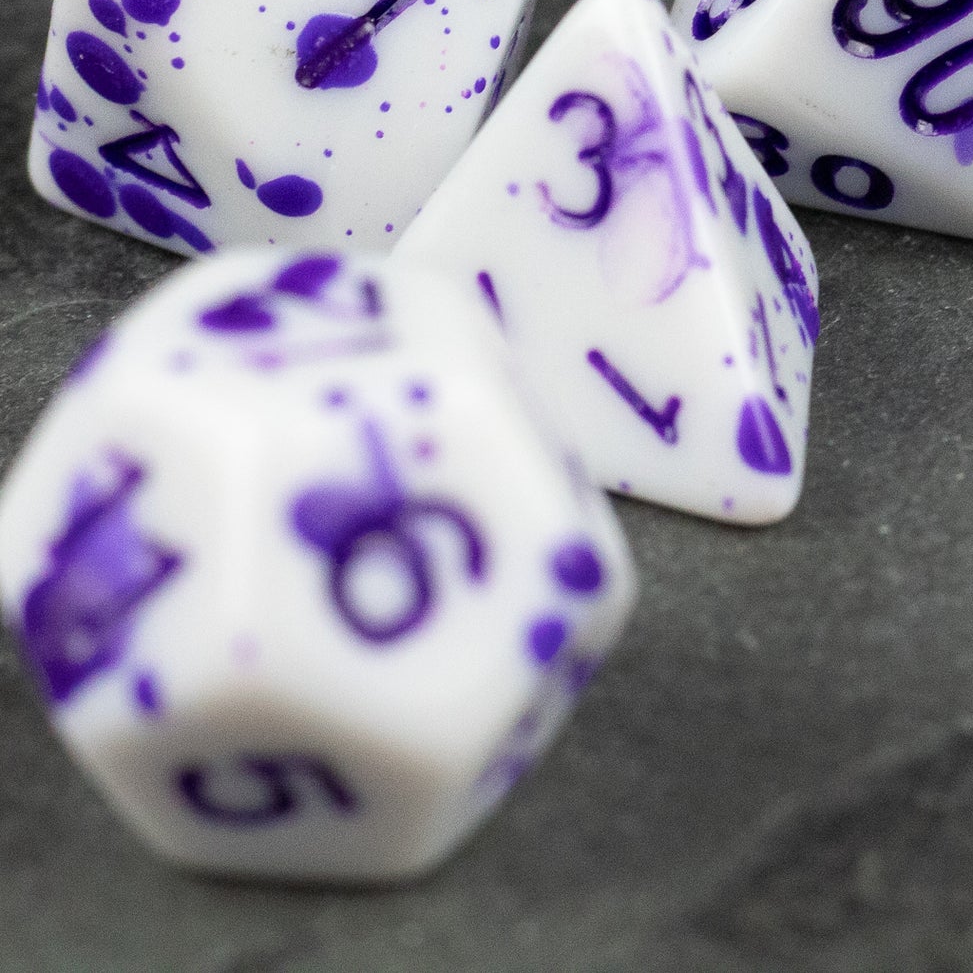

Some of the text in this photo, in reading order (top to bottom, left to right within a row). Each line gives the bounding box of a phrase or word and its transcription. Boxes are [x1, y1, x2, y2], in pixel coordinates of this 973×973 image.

[98, 109, 212, 209] 4
[539, 91, 617, 228] 3
[586, 347, 682, 446] 1
